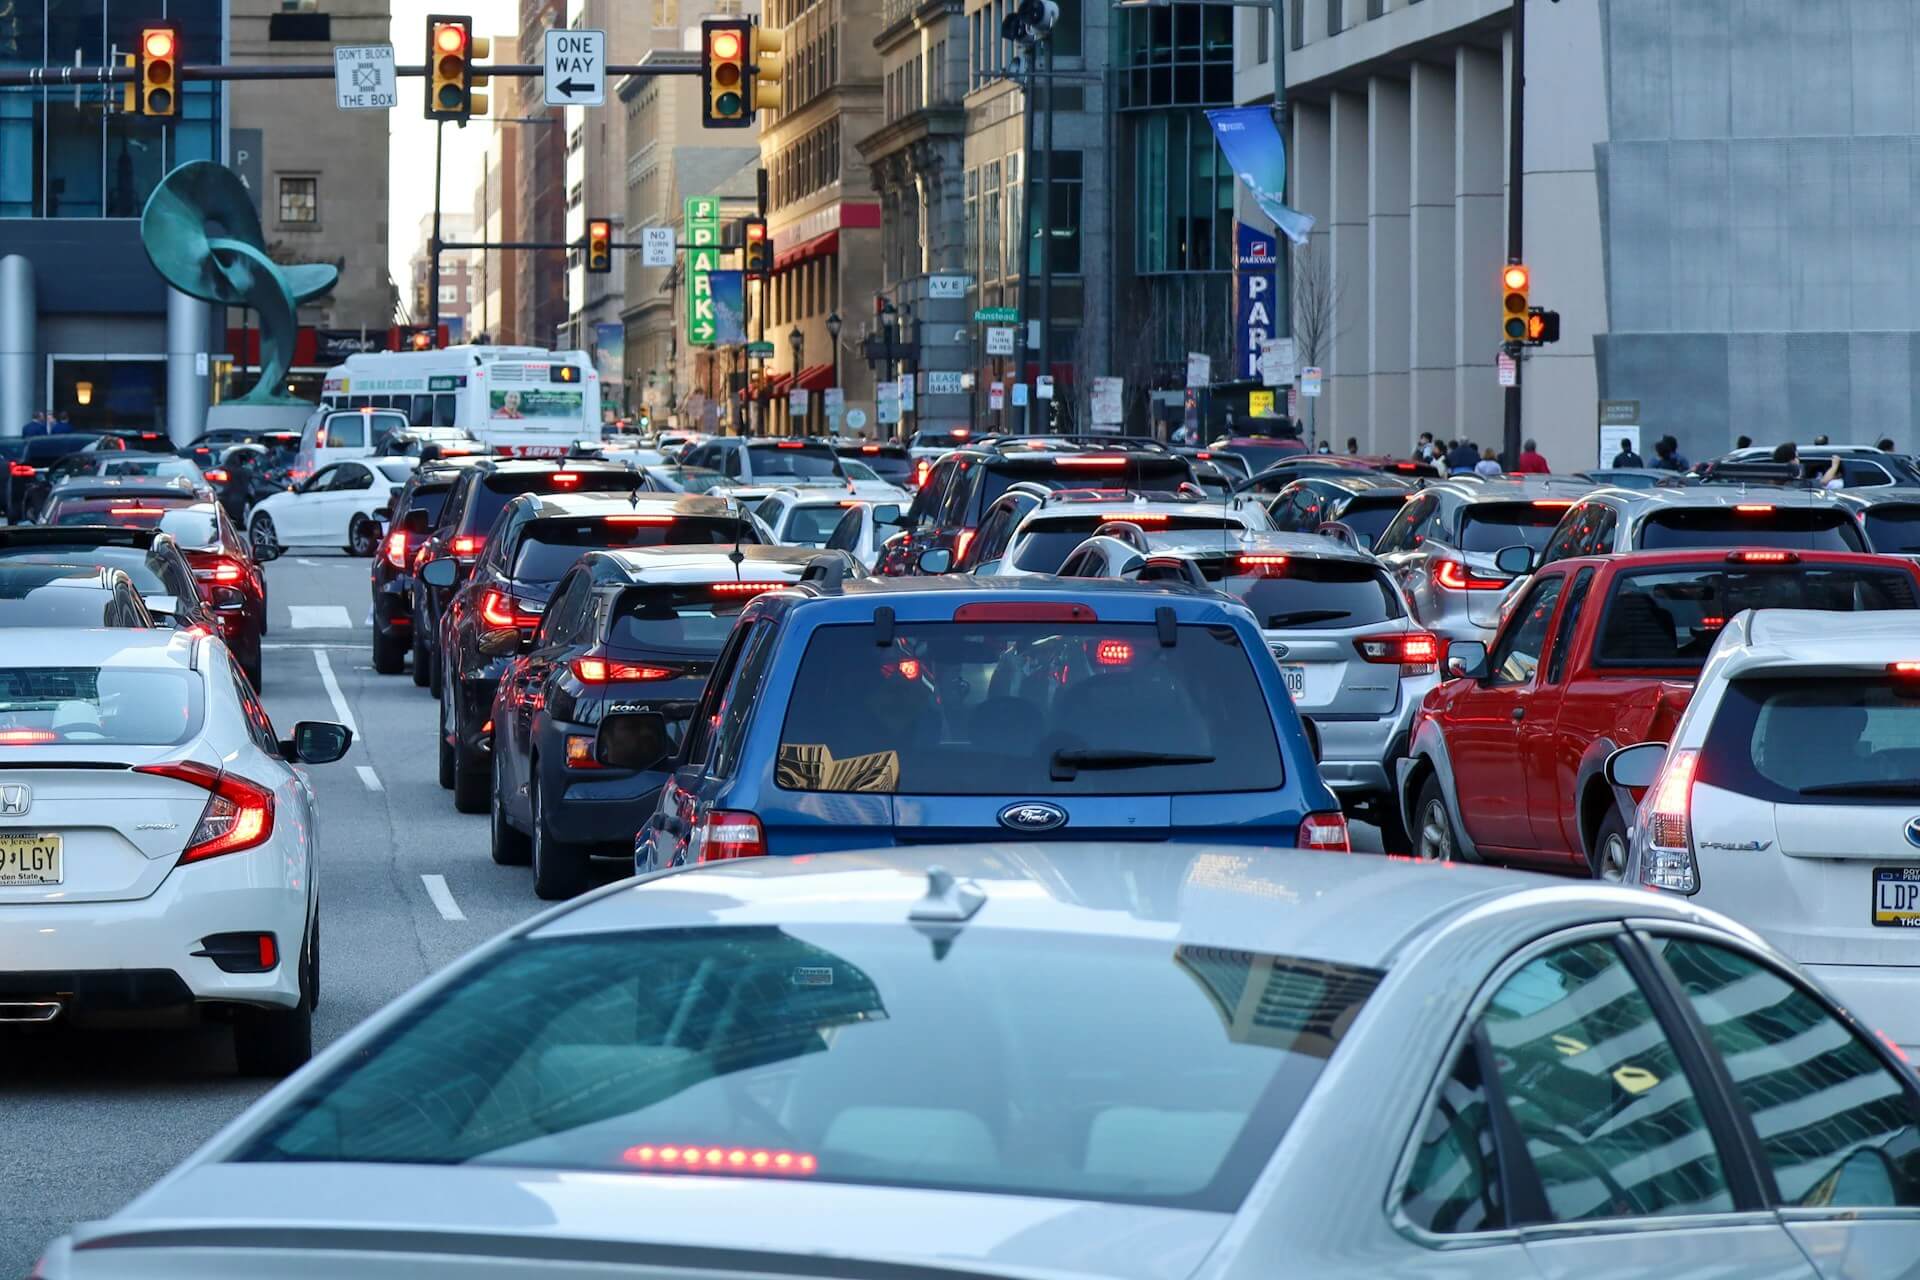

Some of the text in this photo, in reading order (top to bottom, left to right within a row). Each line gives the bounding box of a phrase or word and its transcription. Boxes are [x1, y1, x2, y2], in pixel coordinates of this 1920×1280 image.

[557, 37, 593, 53] ONE
[338, 49, 392, 60] DON'T BLOCK
[556, 57, 594, 73] WAY
[344, 94, 393, 106] THE BOX
[650, 231, 666, 239] NO
[1239, 256, 1276, 264] PARKWAY
[694, 229, 713, 320] PARK
[974, 311, 1015, 321] Ranstead
[1248, 276, 1270, 377] PARK
[525, 447, 561, 457] SEPTA
[1284, 673, 1303, 690] 08
[610, 704, 650, 712] KONA
[1018, 808, 1049, 823] Ford
[135, 823, 180, 831] SPORT
[10, 839, 36, 848] Jersey
[20, 847, 54, 871] LGY
[1881, 884, 1919, 910] LDP
